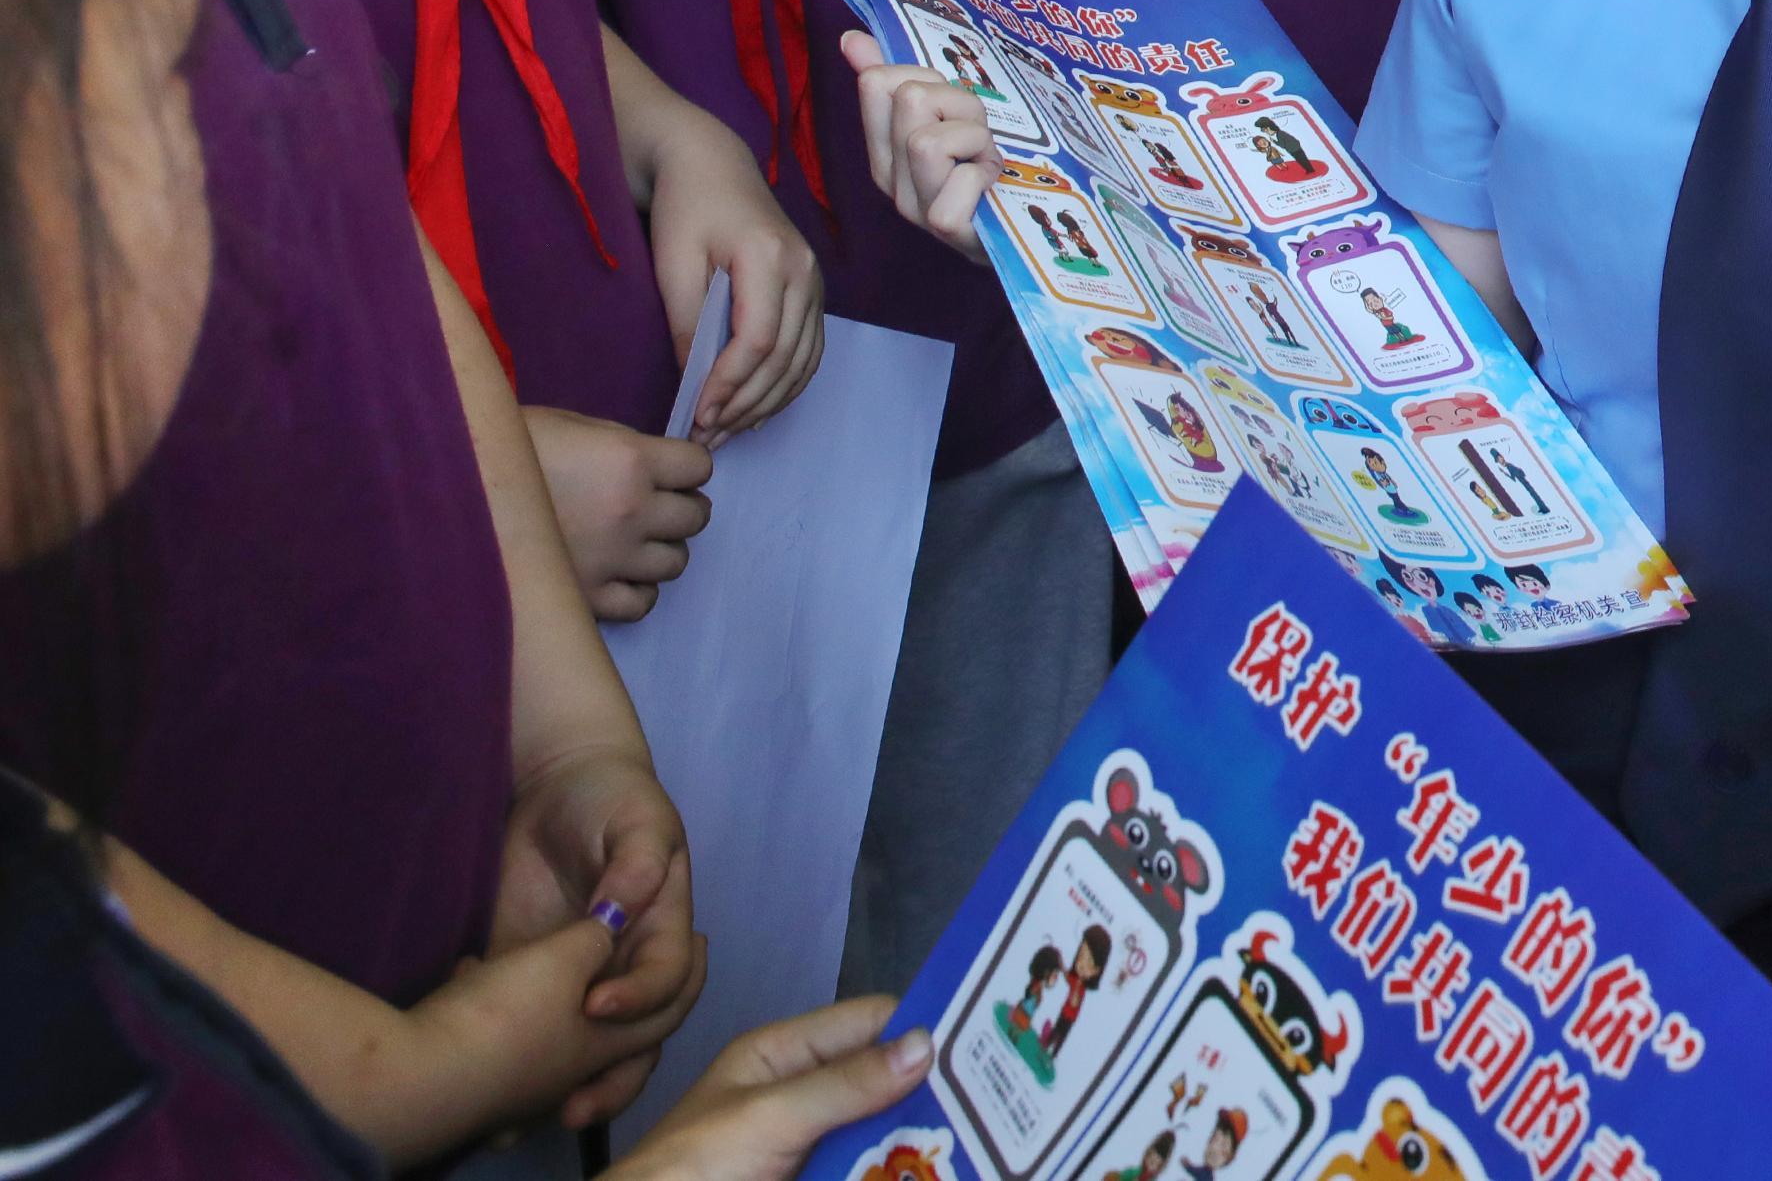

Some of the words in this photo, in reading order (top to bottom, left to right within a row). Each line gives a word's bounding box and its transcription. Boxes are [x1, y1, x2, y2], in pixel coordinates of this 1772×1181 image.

[1495, 593, 1625, 631] 开封检察机关
[1620, 589, 1650, 612] 宣
[1228, 601, 1363, 751] 保护
